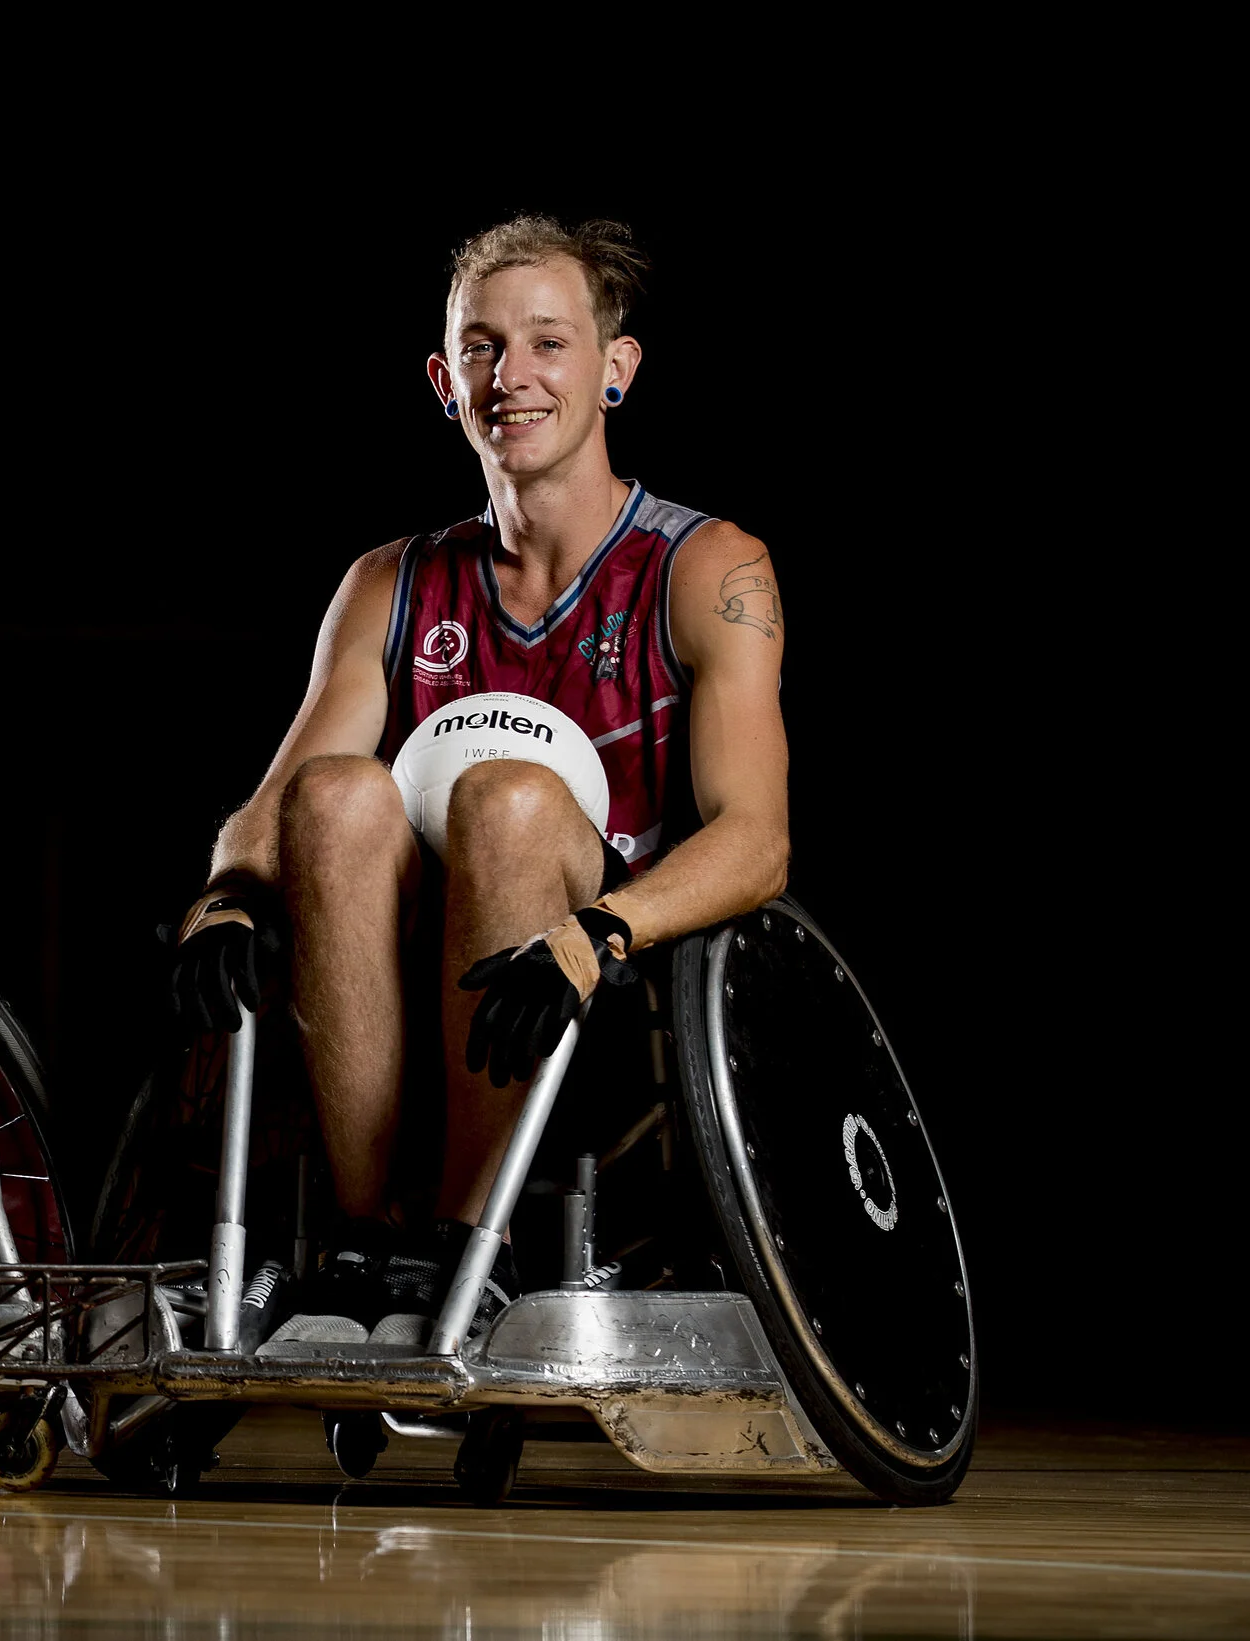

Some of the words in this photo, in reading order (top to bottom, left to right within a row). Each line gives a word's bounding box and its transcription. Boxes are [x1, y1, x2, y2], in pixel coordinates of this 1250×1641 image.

[577, 609, 629, 659] CYLON
[434, 709, 554, 744] molten
[464, 748, 510, 759] IWRF
